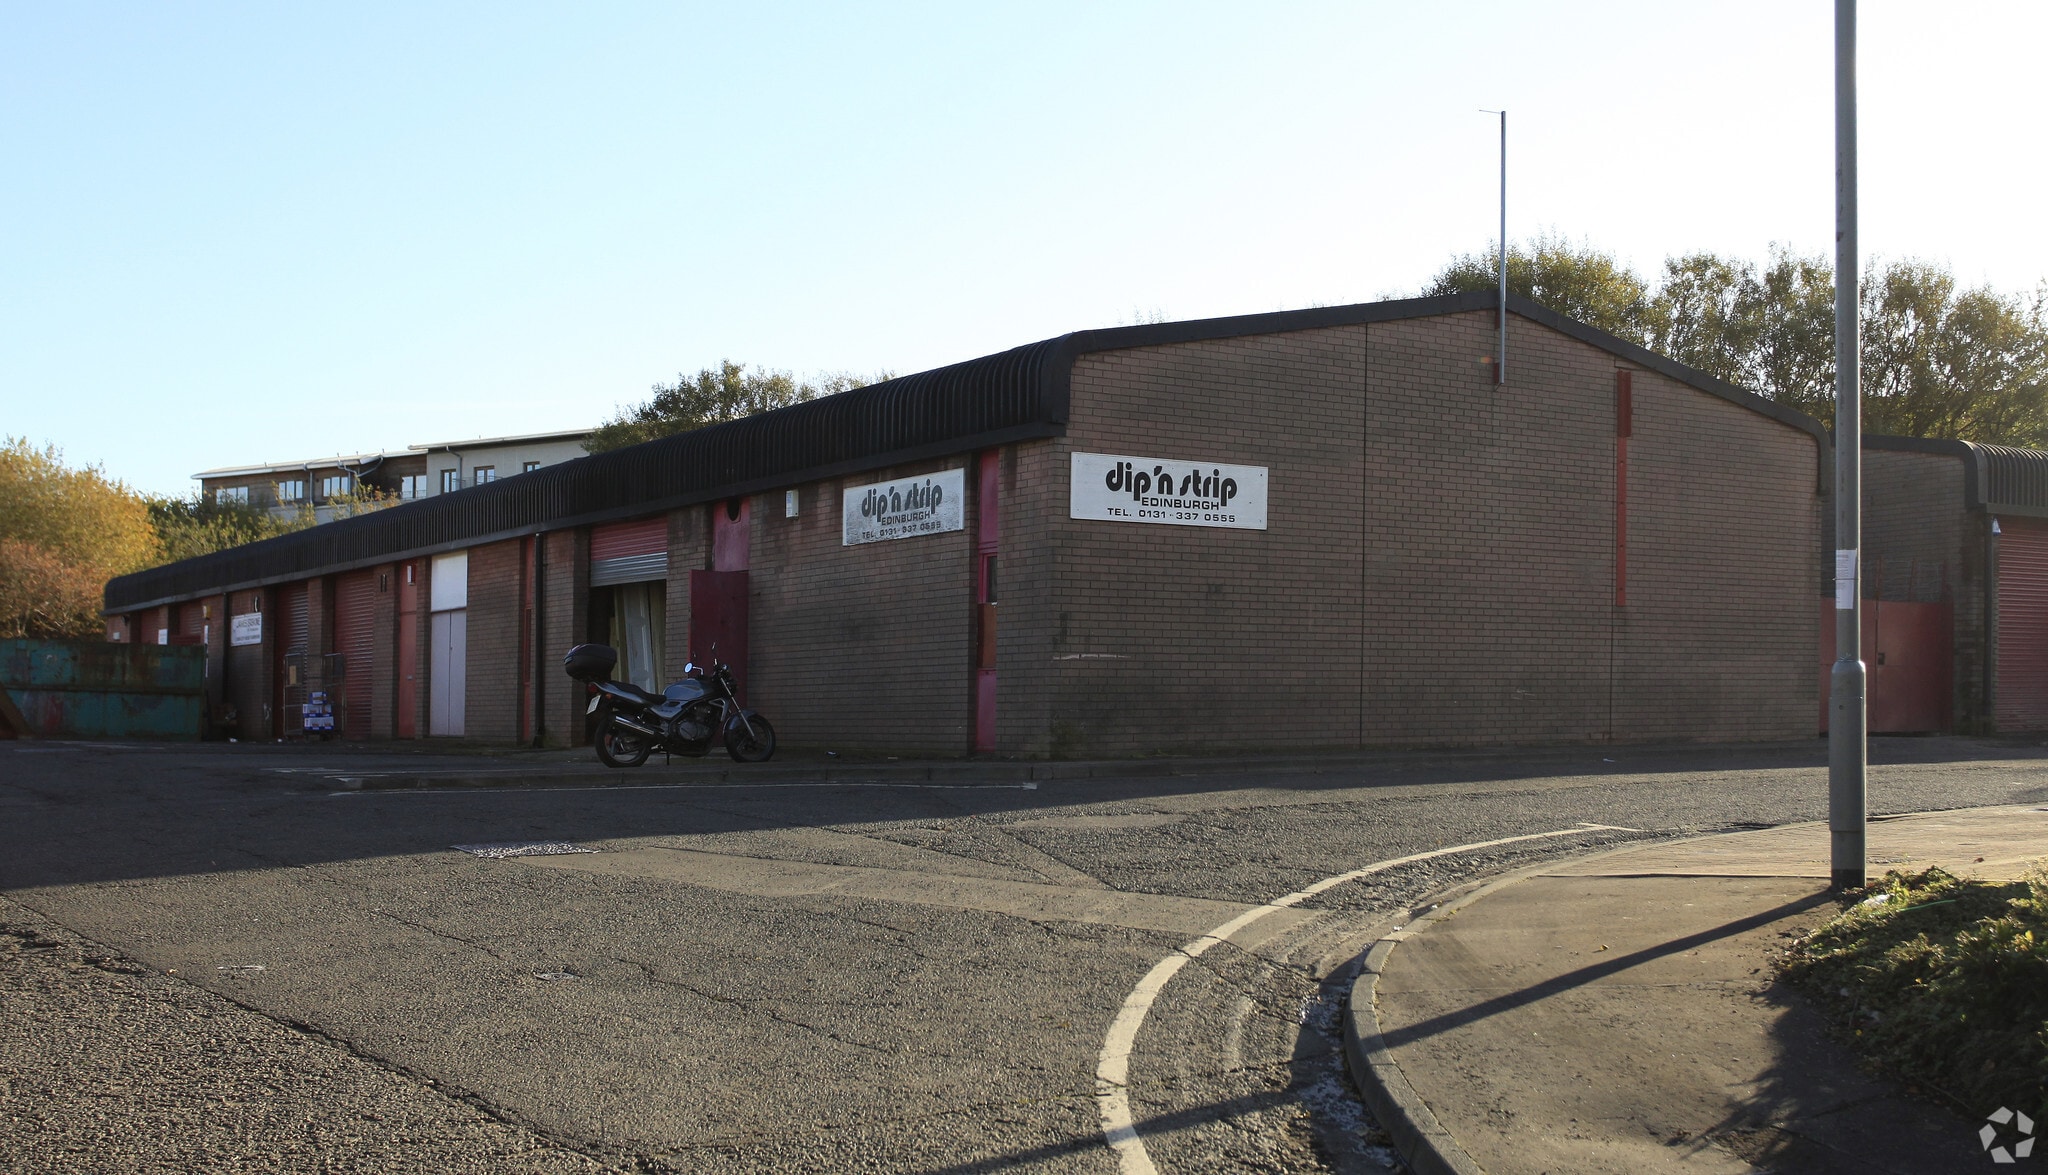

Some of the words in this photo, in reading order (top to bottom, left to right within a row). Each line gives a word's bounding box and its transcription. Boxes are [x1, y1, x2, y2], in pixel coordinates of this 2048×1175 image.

[1105, 461, 1173, 501] dip'n
[1179, 468, 1238, 506] strip
[861, 486, 901, 522] dip'n
[904, 479, 943, 514] strip
[1141, 497, 1219, 510] EDINBURGH
[881, 511, 931, 526] EDINBURGH
[1107, 508, 1132, 517] TEL.
[1138, 510, 1166, 519] 0131
[1176, 512, 1199, 521] 337
[1204, 513, 1236, 522] 0555
